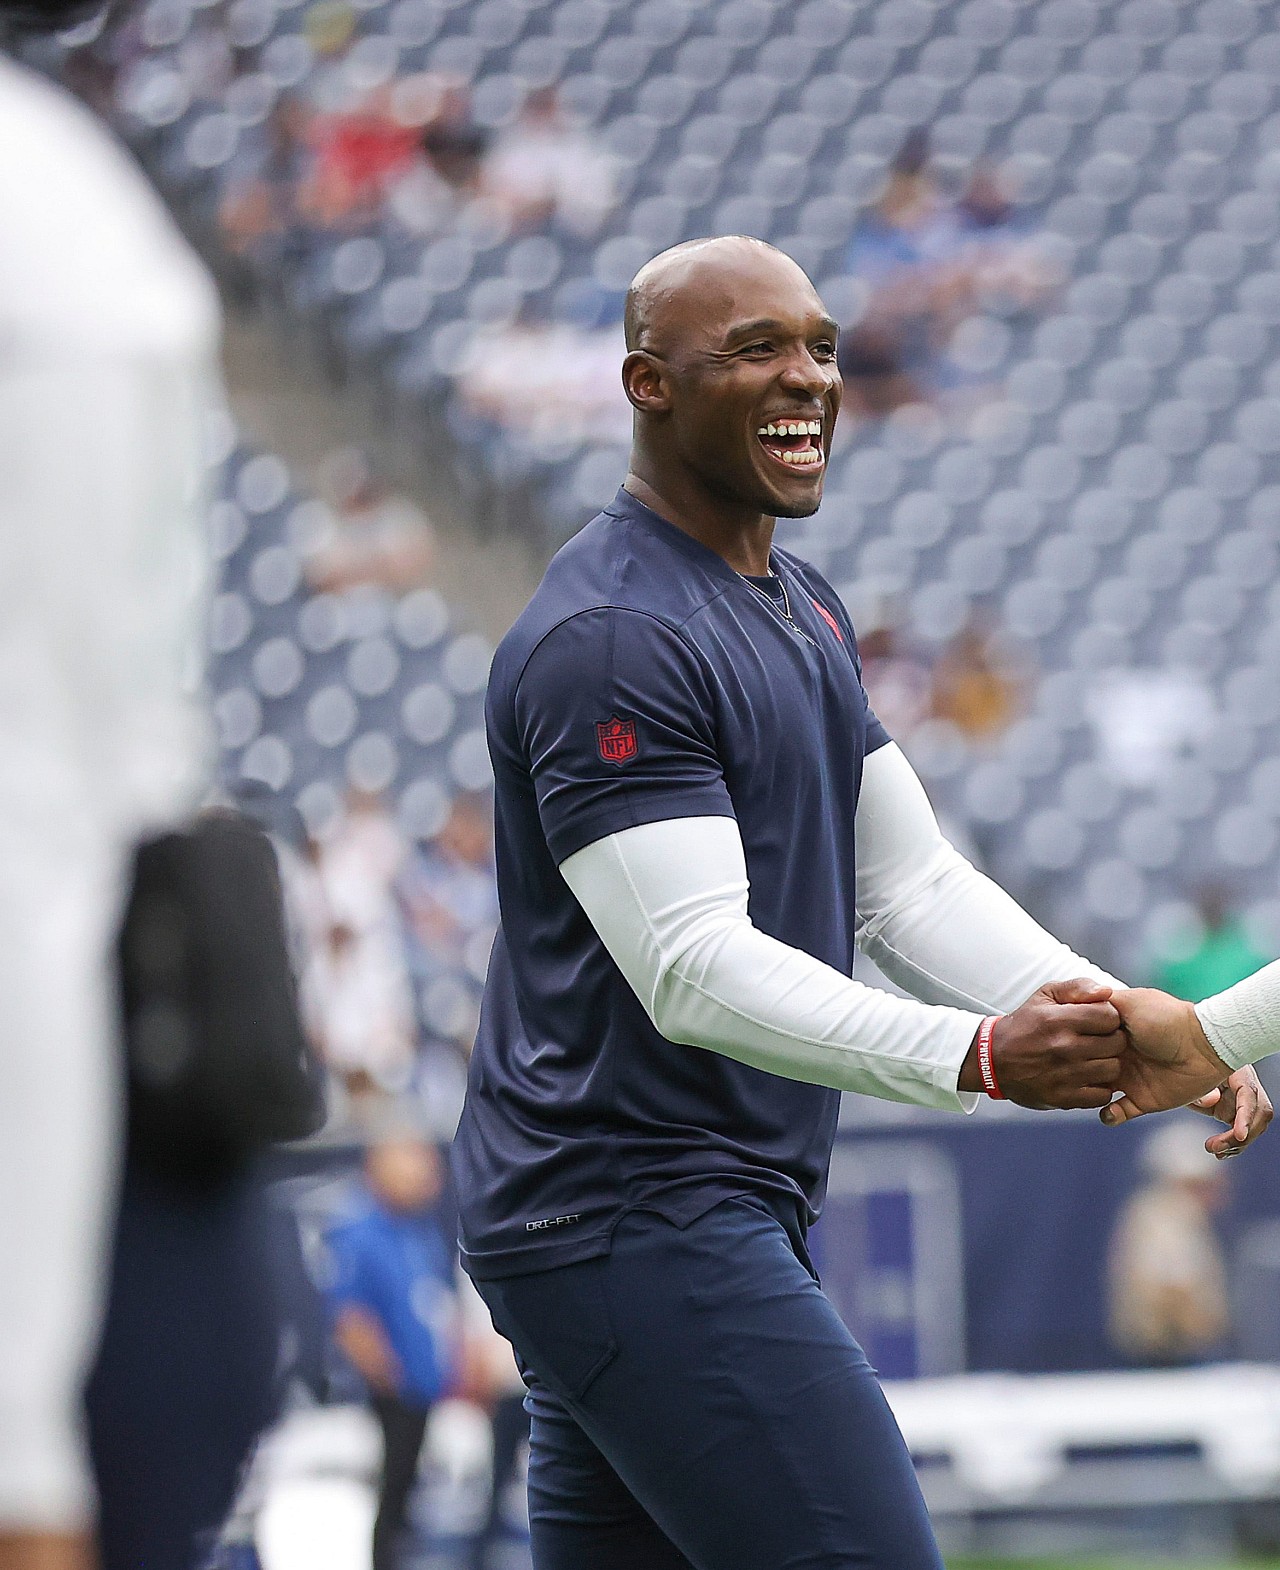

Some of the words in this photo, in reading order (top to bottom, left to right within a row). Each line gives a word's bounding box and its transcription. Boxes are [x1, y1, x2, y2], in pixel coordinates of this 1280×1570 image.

[604, 737, 633, 755] NFL
[980, 1042, 996, 1090] PHYSICALITY
[526, 1213, 581, 1231] DRI-FIT
